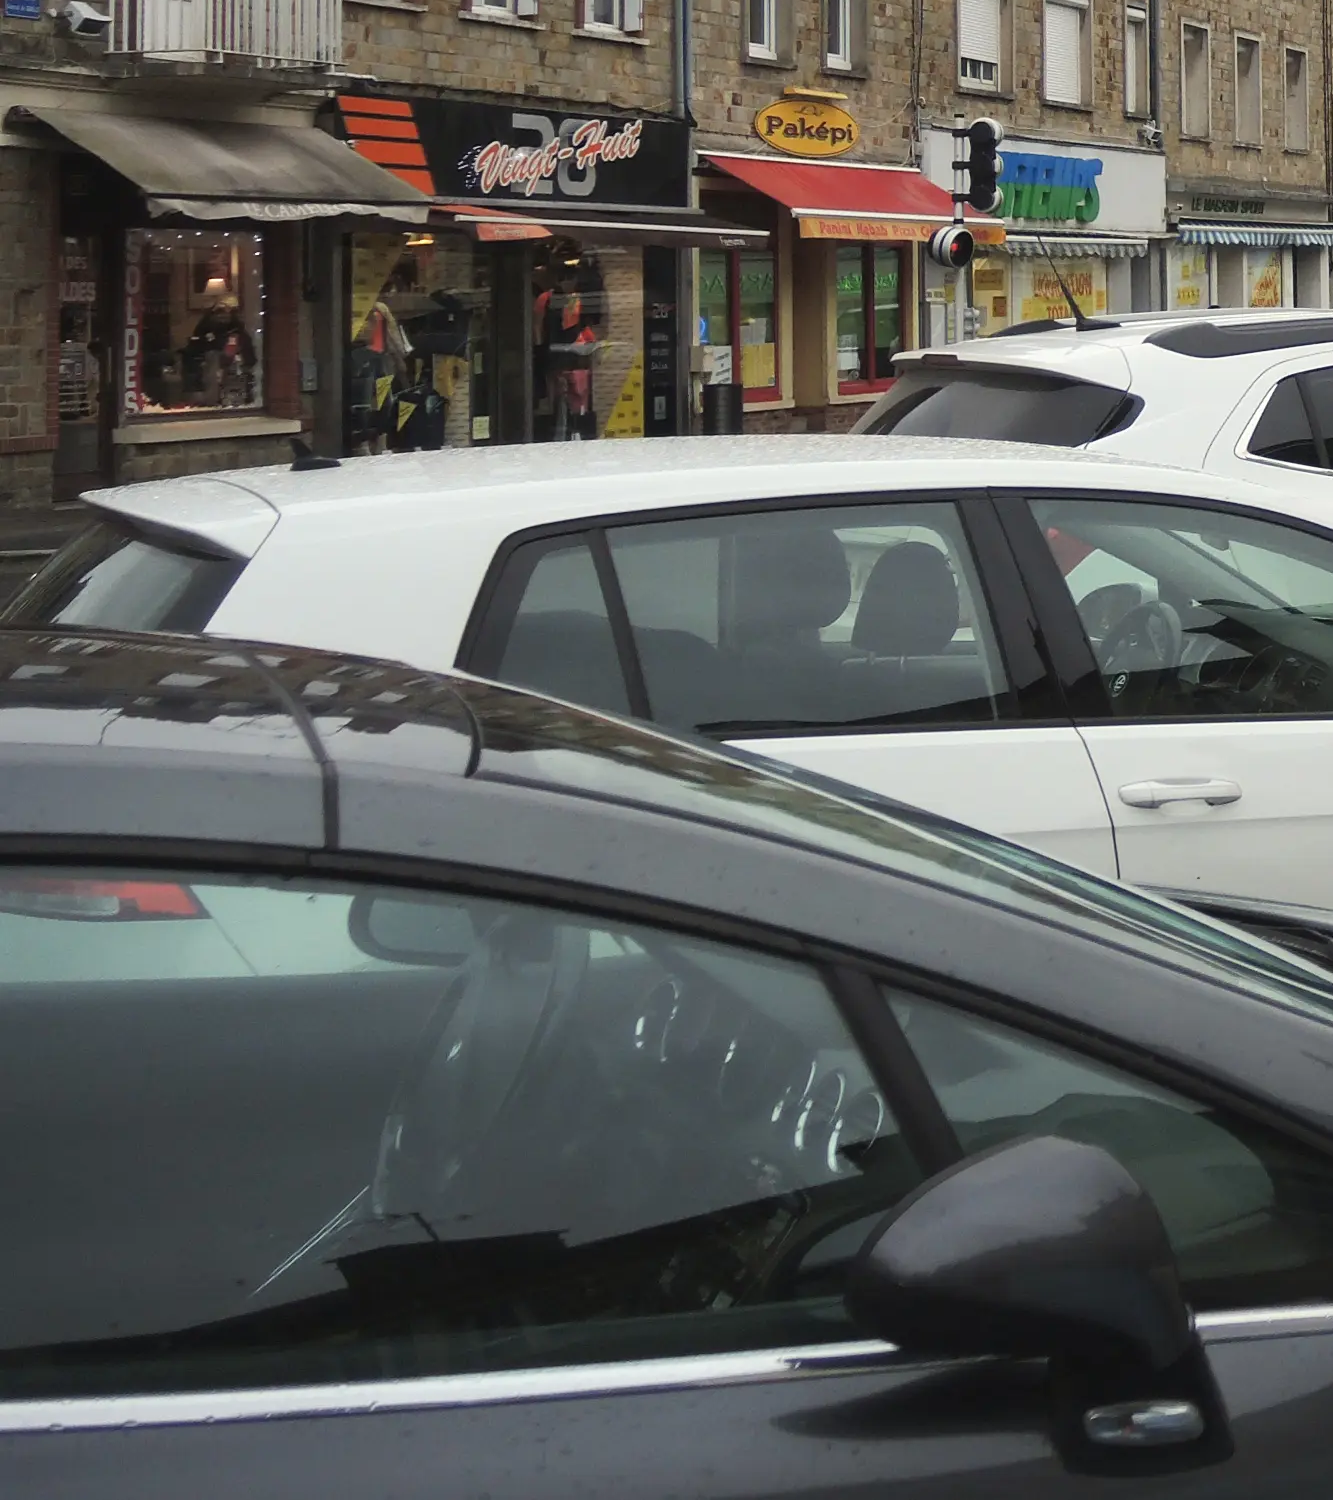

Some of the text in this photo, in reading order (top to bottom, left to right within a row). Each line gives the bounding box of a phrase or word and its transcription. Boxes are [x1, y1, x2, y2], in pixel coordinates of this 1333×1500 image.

[475, 119, 643, 197] Vingt-Huit
[765, 115, 854, 146] Paképi
[125, 233, 141, 415] SOLDES
